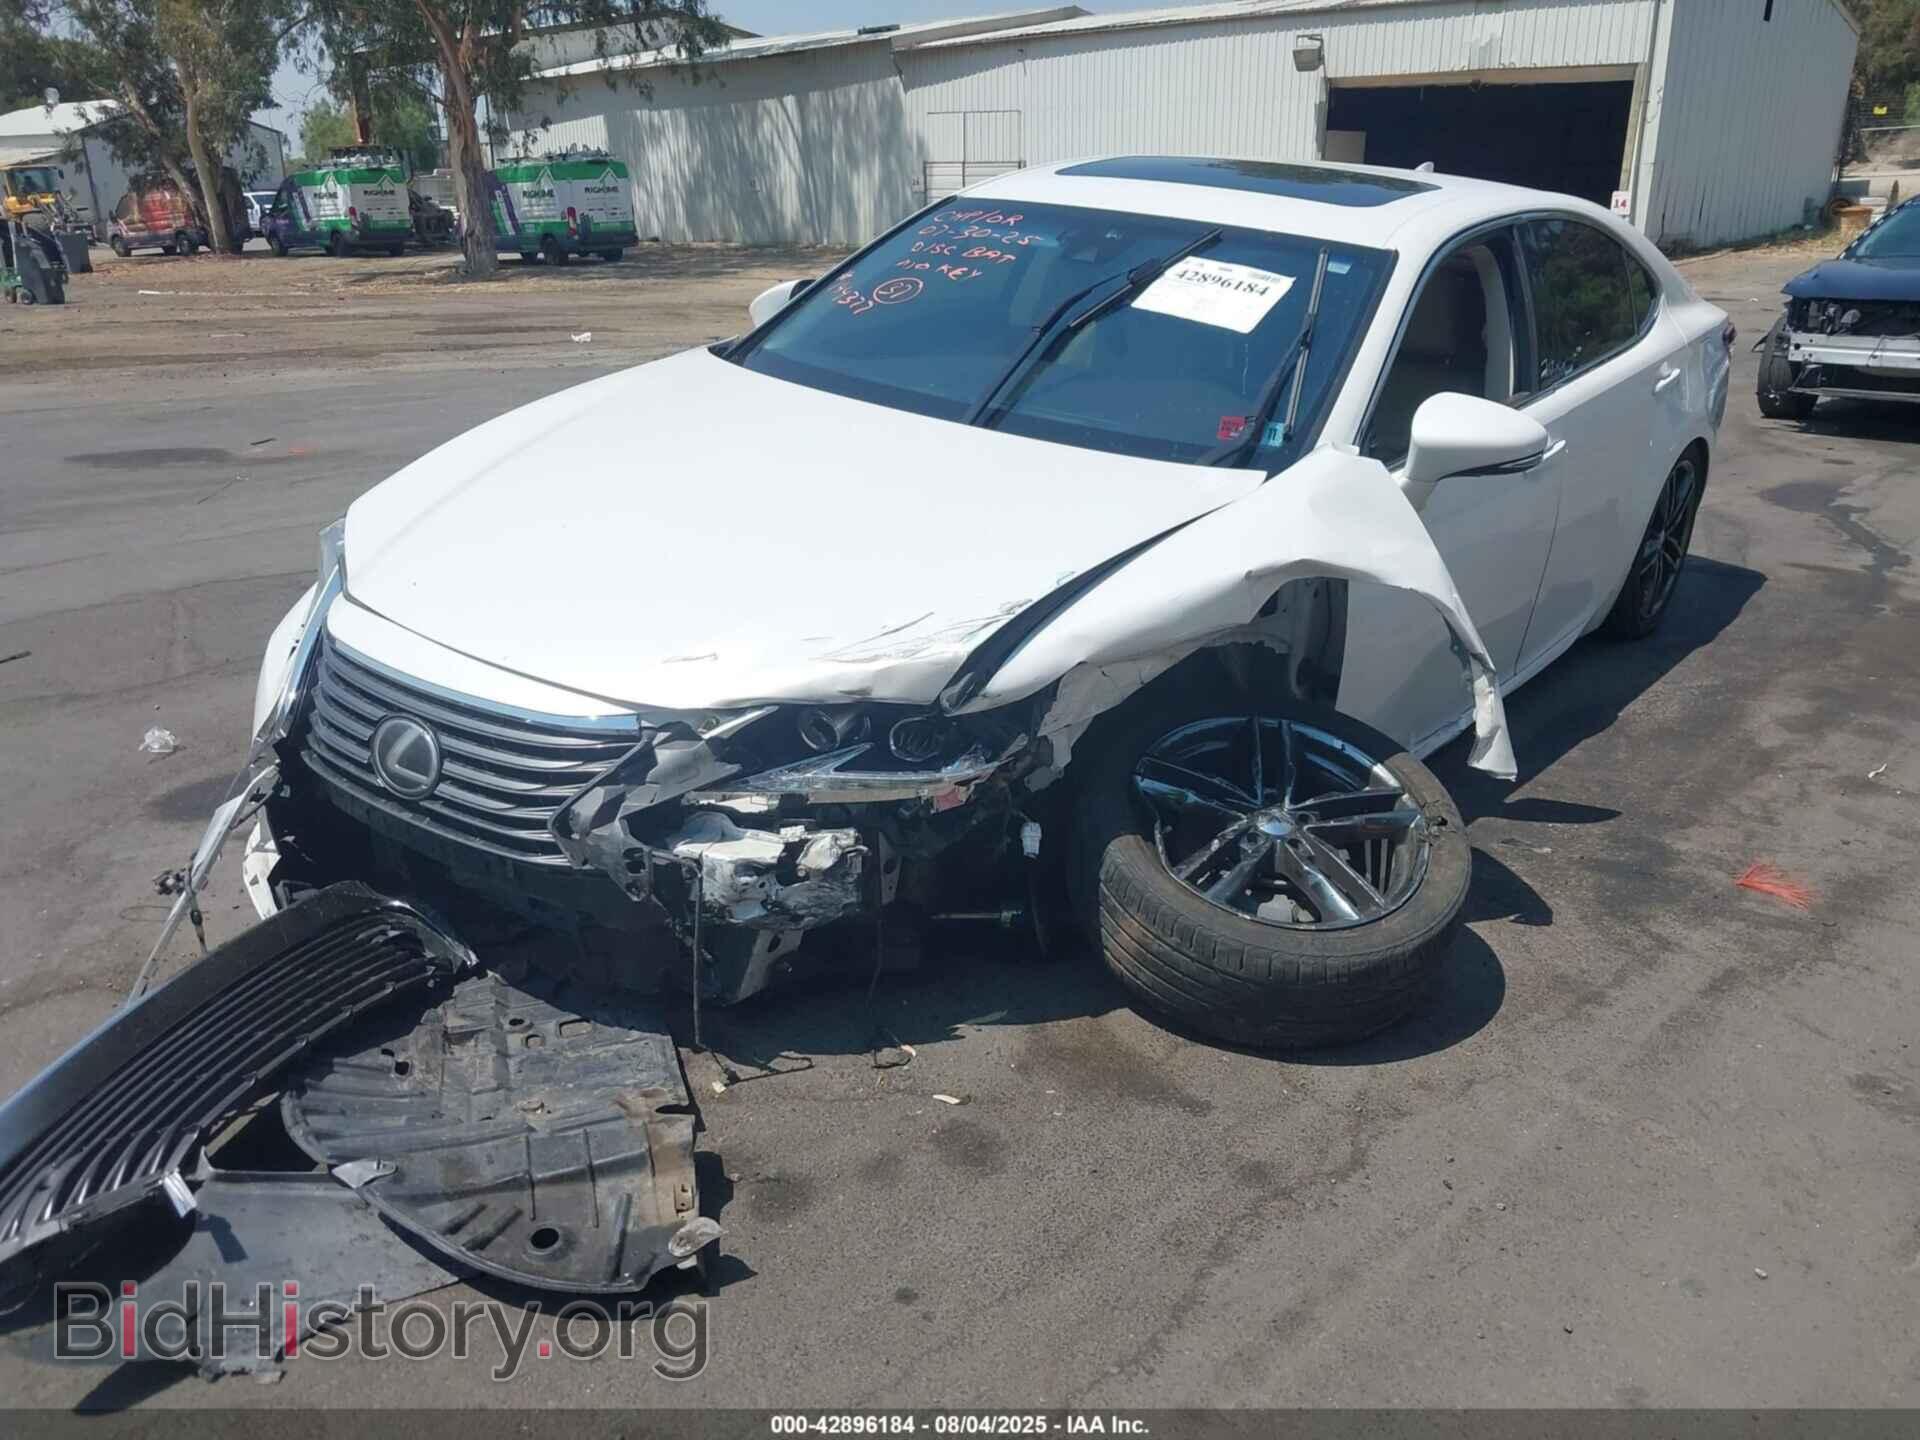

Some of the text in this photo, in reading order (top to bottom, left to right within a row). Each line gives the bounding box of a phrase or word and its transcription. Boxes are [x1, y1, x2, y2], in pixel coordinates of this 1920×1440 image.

[1613, 198, 1627, 209] 14
[911, 241, 957, 256] DISC
[935, 263, 983, 280] KEY
[1175, 269, 1270, 296] 42896184
